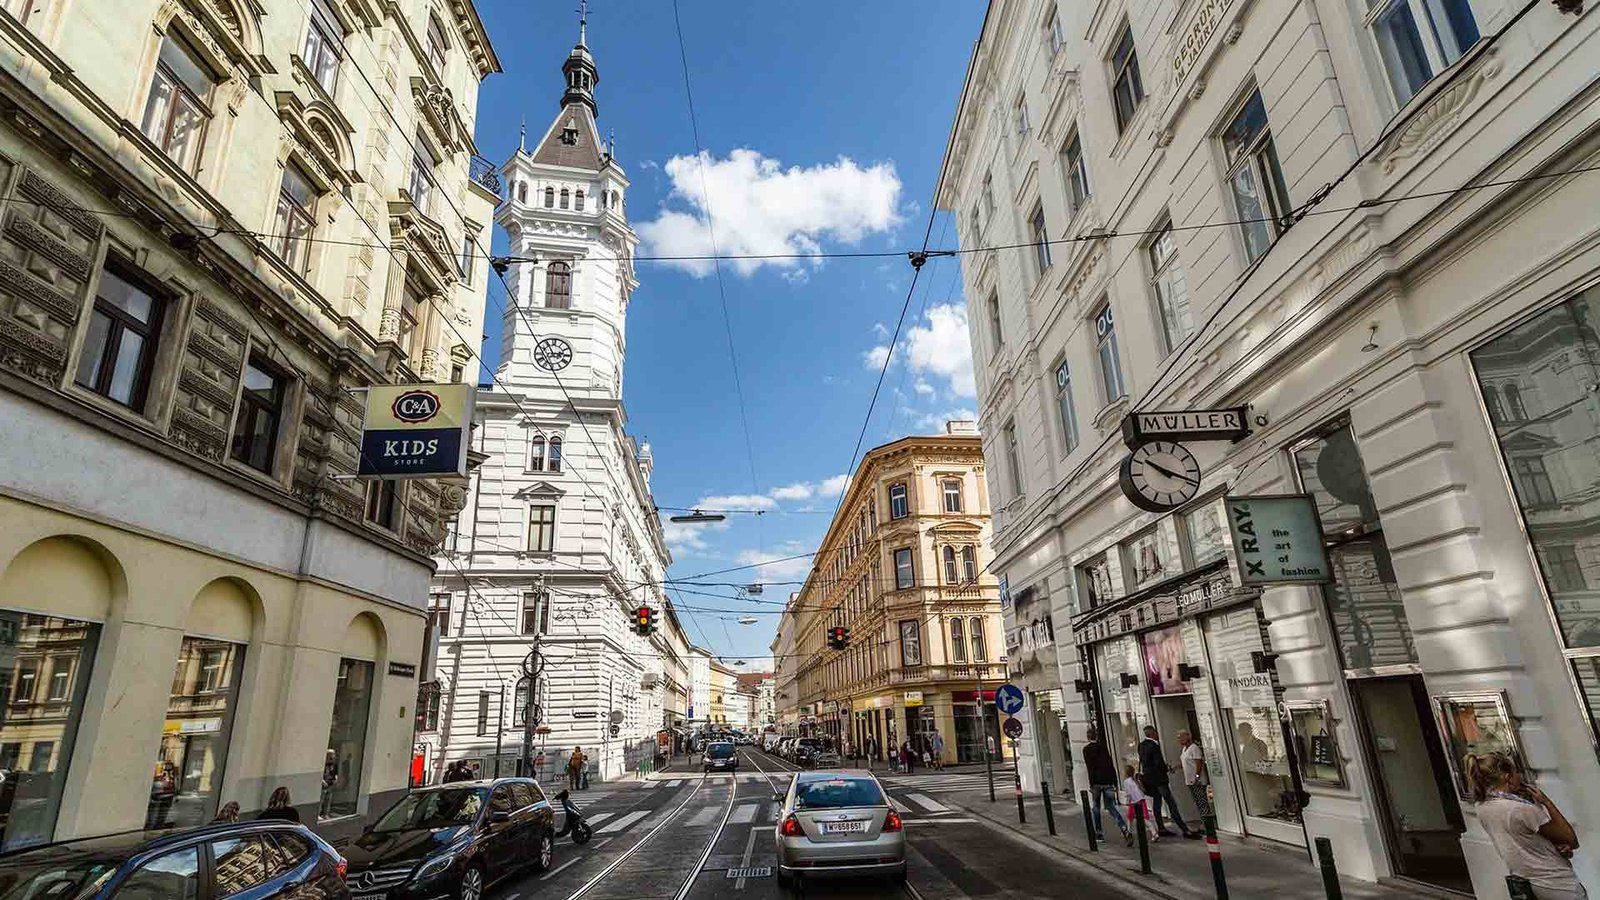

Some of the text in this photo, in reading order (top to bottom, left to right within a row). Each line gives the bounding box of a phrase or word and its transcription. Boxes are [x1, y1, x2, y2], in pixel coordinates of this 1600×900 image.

[1174, 0, 1220, 70] GEGRÜN
[1174, 70, 1186, 87] IM
[1187, 15, 1217, 66] JAHRE
[401, 398, 432, 414] C&A
[1143, 414, 1239, 431] MÜLLER
[384, 438, 438, 456] KIDS
[394, 458, 425, 466] STORE
[1232, 506, 1265, 576] X RAY
[1272, 529, 1290, 538] the
[1275, 542, 1292, 550] art
[1278, 554, 1289, 562] of
[1282, 567, 1320, 576] fashion
